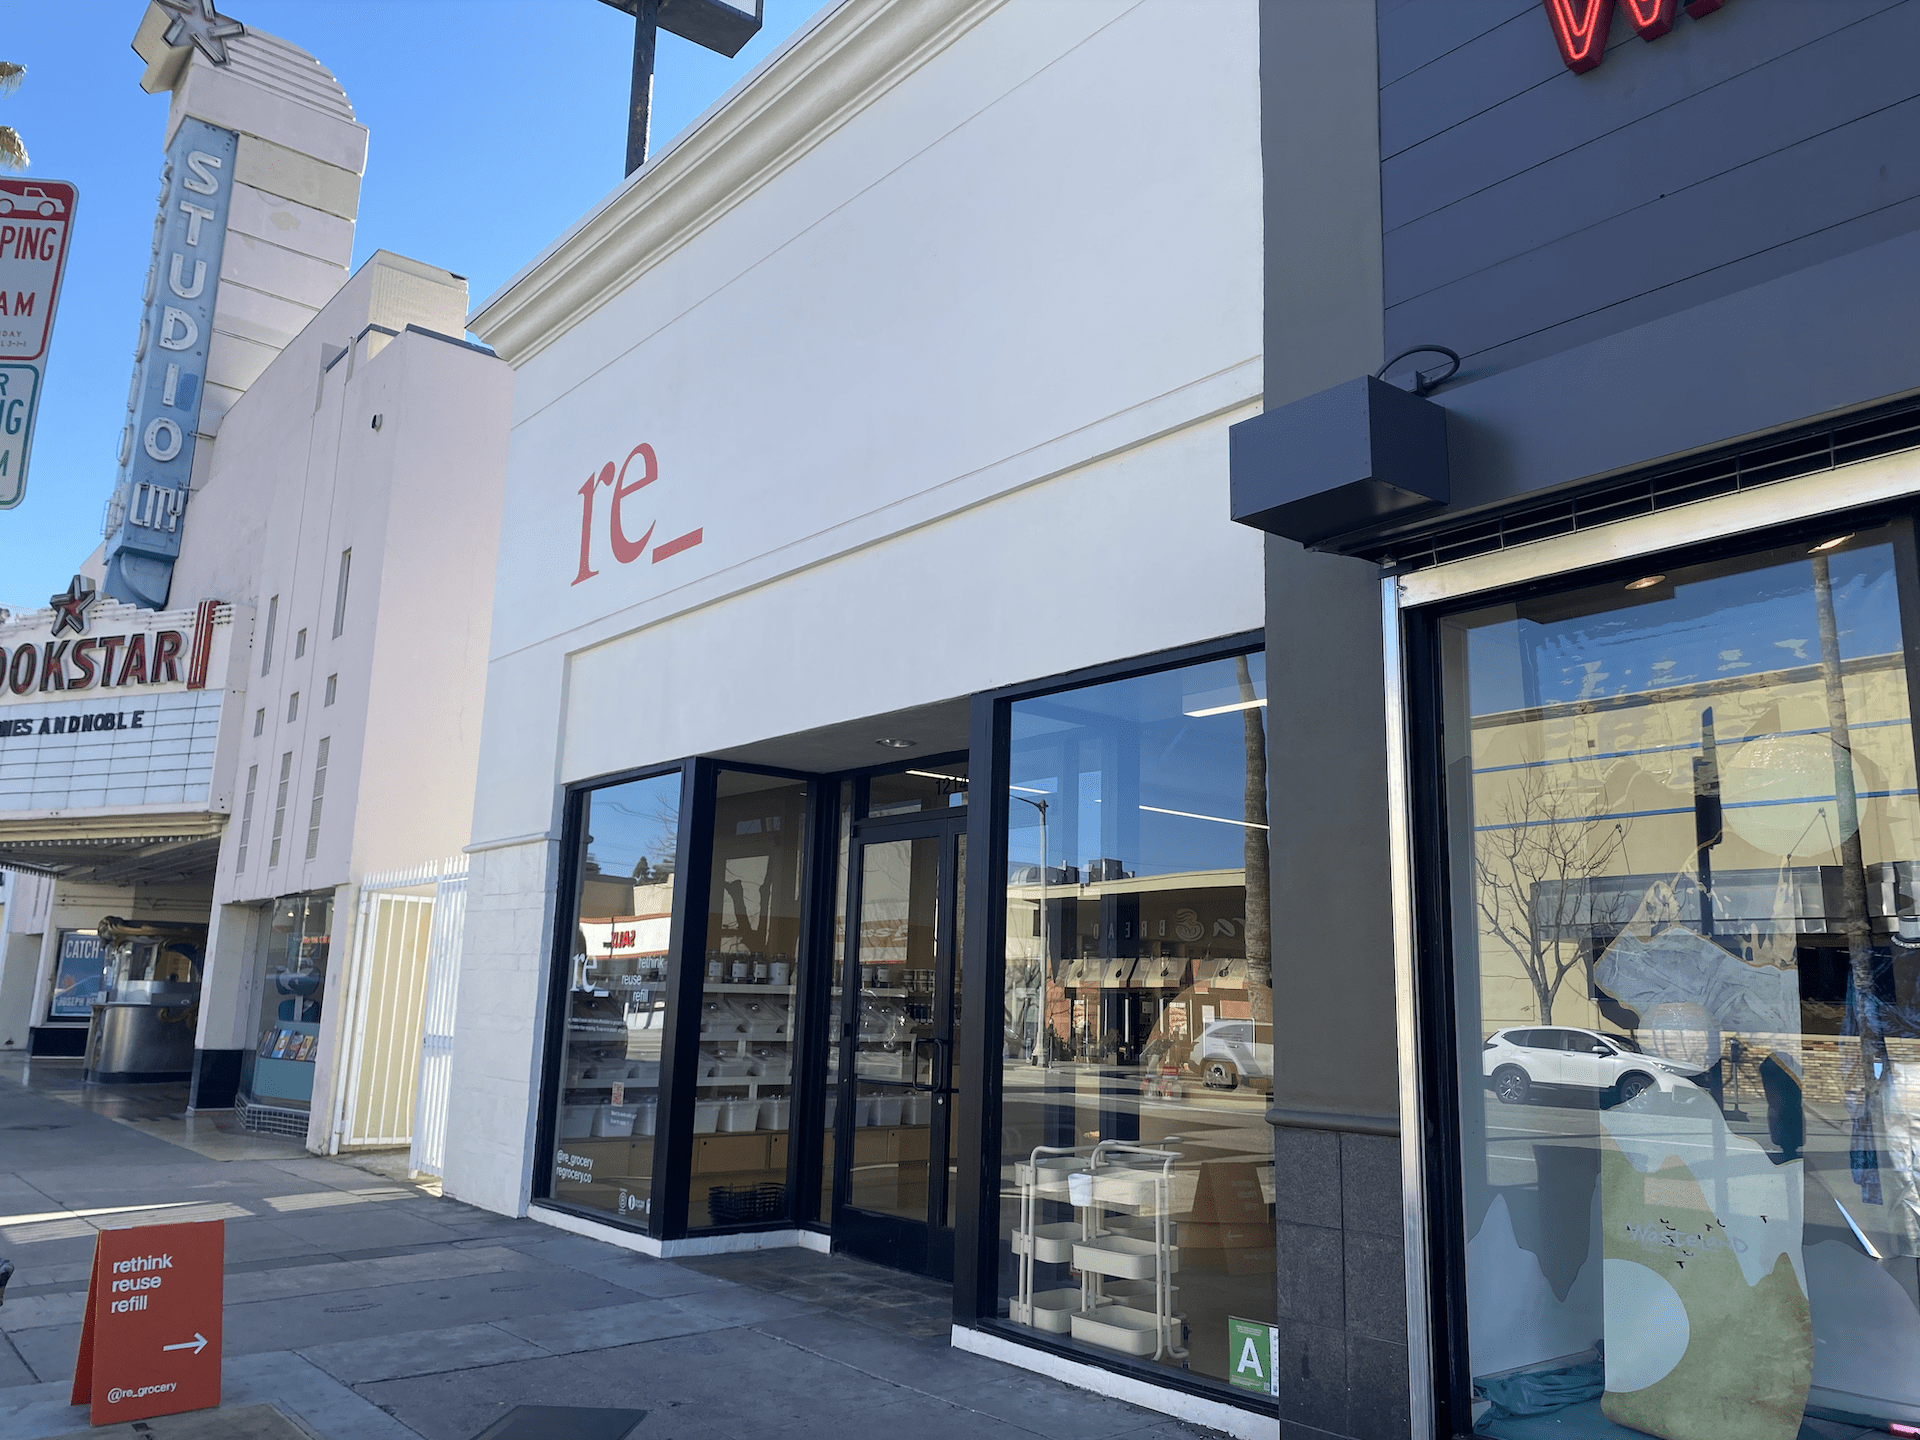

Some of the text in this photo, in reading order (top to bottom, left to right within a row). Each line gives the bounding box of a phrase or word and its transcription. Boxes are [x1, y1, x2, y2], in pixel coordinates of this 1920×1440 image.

[143, 150, 222, 462] STUDIO
[571, 442, 703, 587] re_
[0, 719, 33, 737] NES
[638, 955, 665, 969] rethink
[621, 973, 642, 985] reuse
[112, 1253, 173, 1274] rethink
[111, 1276, 162, 1293] reuse
[110, 1295, 148, 1314] refill
[1237, 1337, 1264, 1378] A
[107, 1382, 177, 1404] @re_grocery
